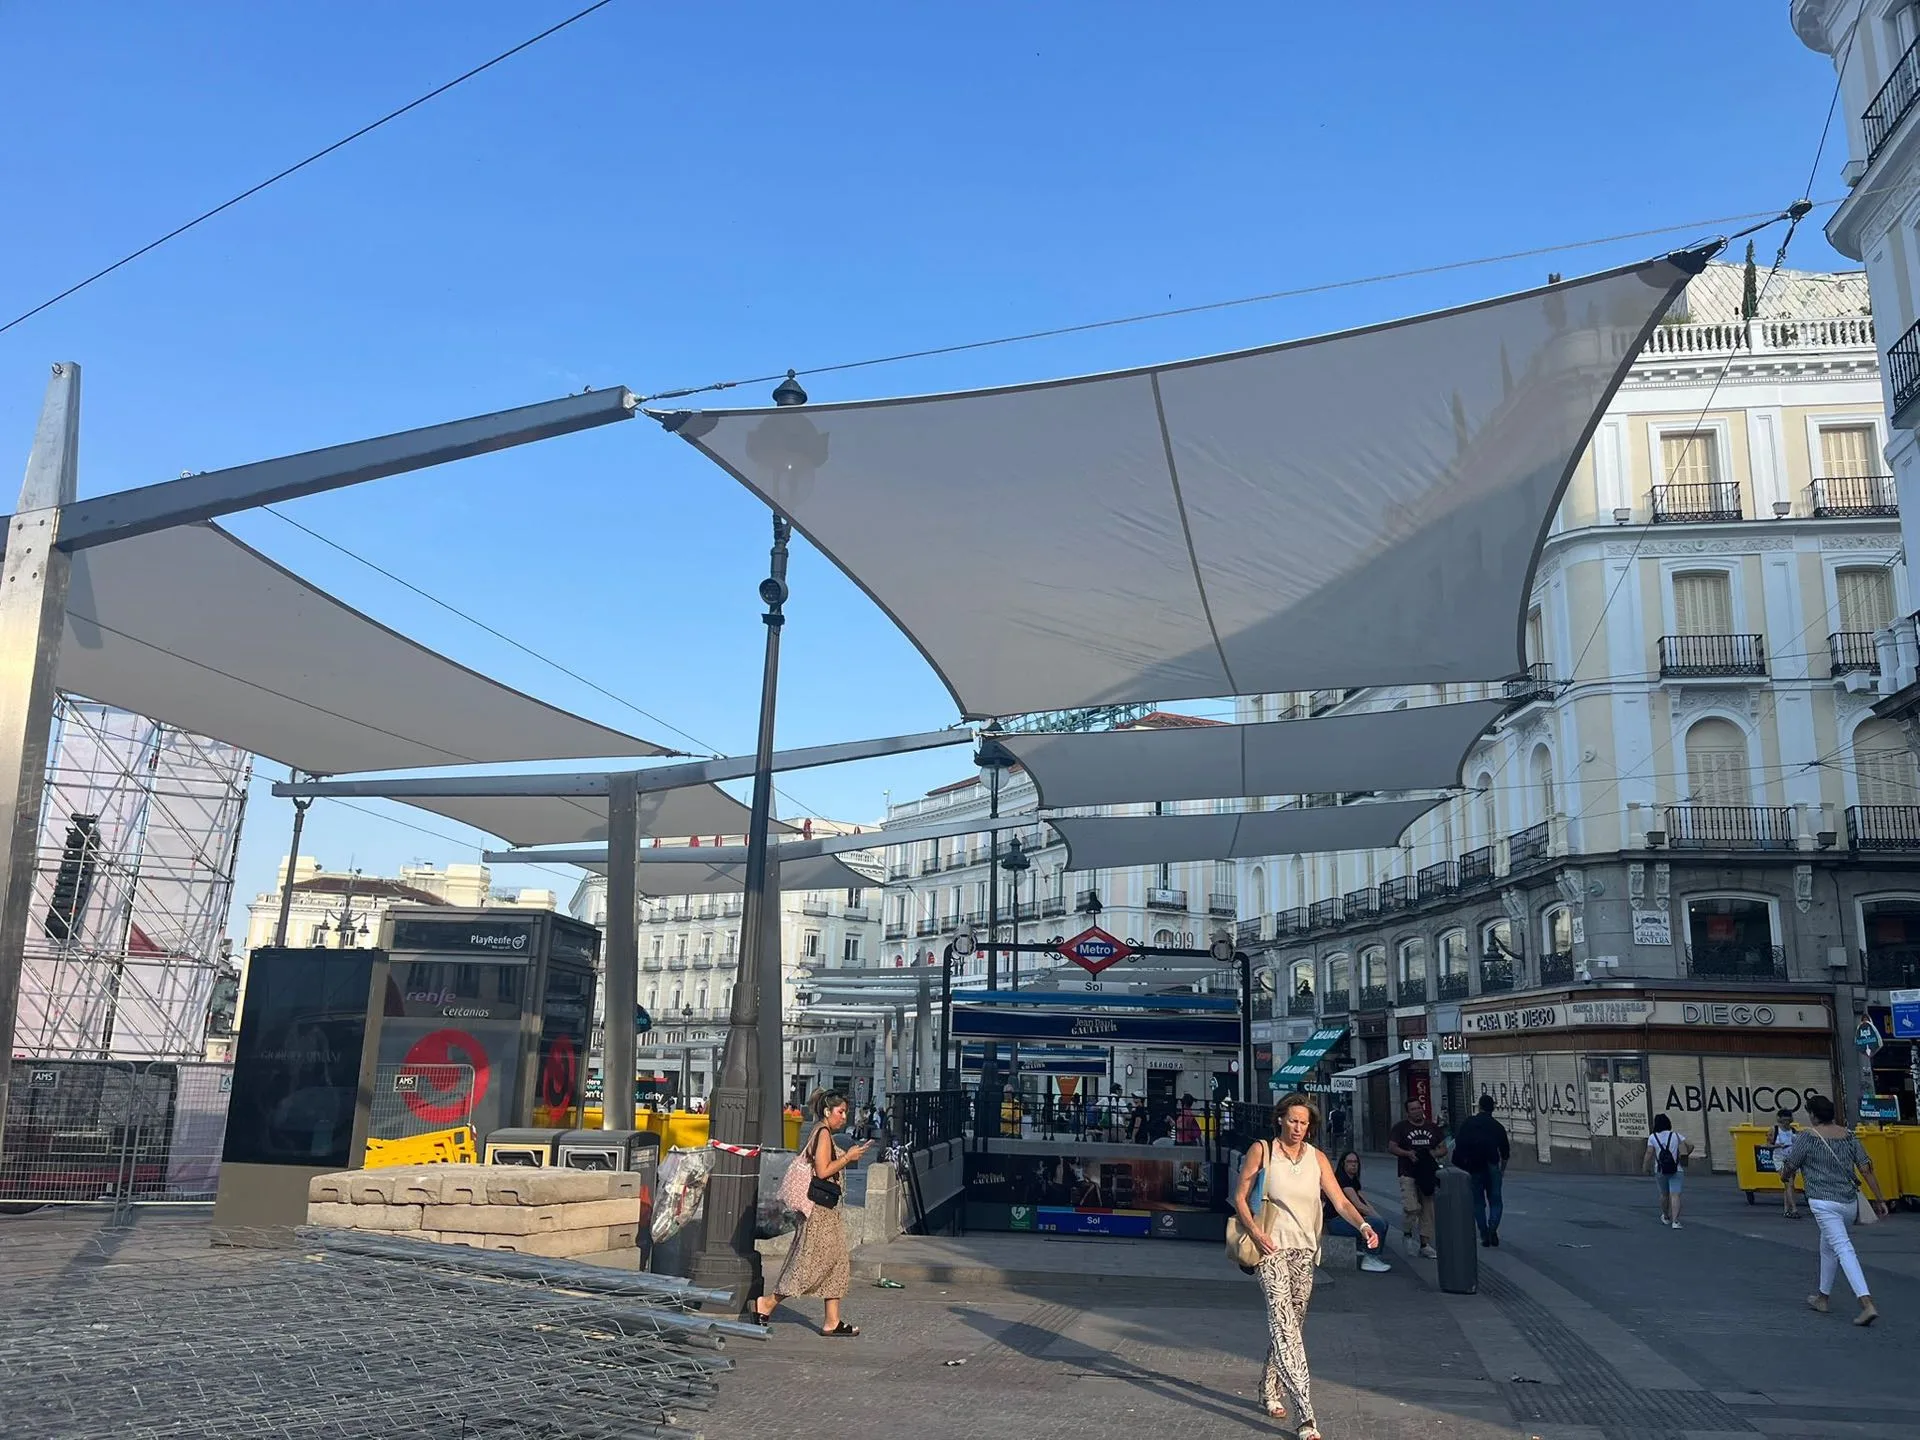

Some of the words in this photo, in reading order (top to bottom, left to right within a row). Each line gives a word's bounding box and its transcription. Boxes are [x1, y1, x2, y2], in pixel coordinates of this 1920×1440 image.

[470, 934, 512, 946] PlayRenfe
[1171, 931, 1194, 949] 1919
[1079, 944, 1111, 956] Metro
[1085, 981, 1103, 992] Sol
[407, 987, 456, 1007] renfe
[1477, 1013, 1500, 1031] CASA
[1505, 1011, 1518, 1029] DE
[1522, 1007, 1555, 1027] DIEGO
[1682, 1003, 1775, 1025] DIEGO
[1075, 1017, 1093, 1027] Jean
[1149, 1061, 1183, 1070] SEPHORA
[35, 1072, 53, 1081] AMS
[399, 1076, 413, 1085] AMS
[644, 1091, 664, 1102] dirty
[1616, 1084, 1646, 1109] DIEGO
[1087, 1216, 1100, 1224] Sol
